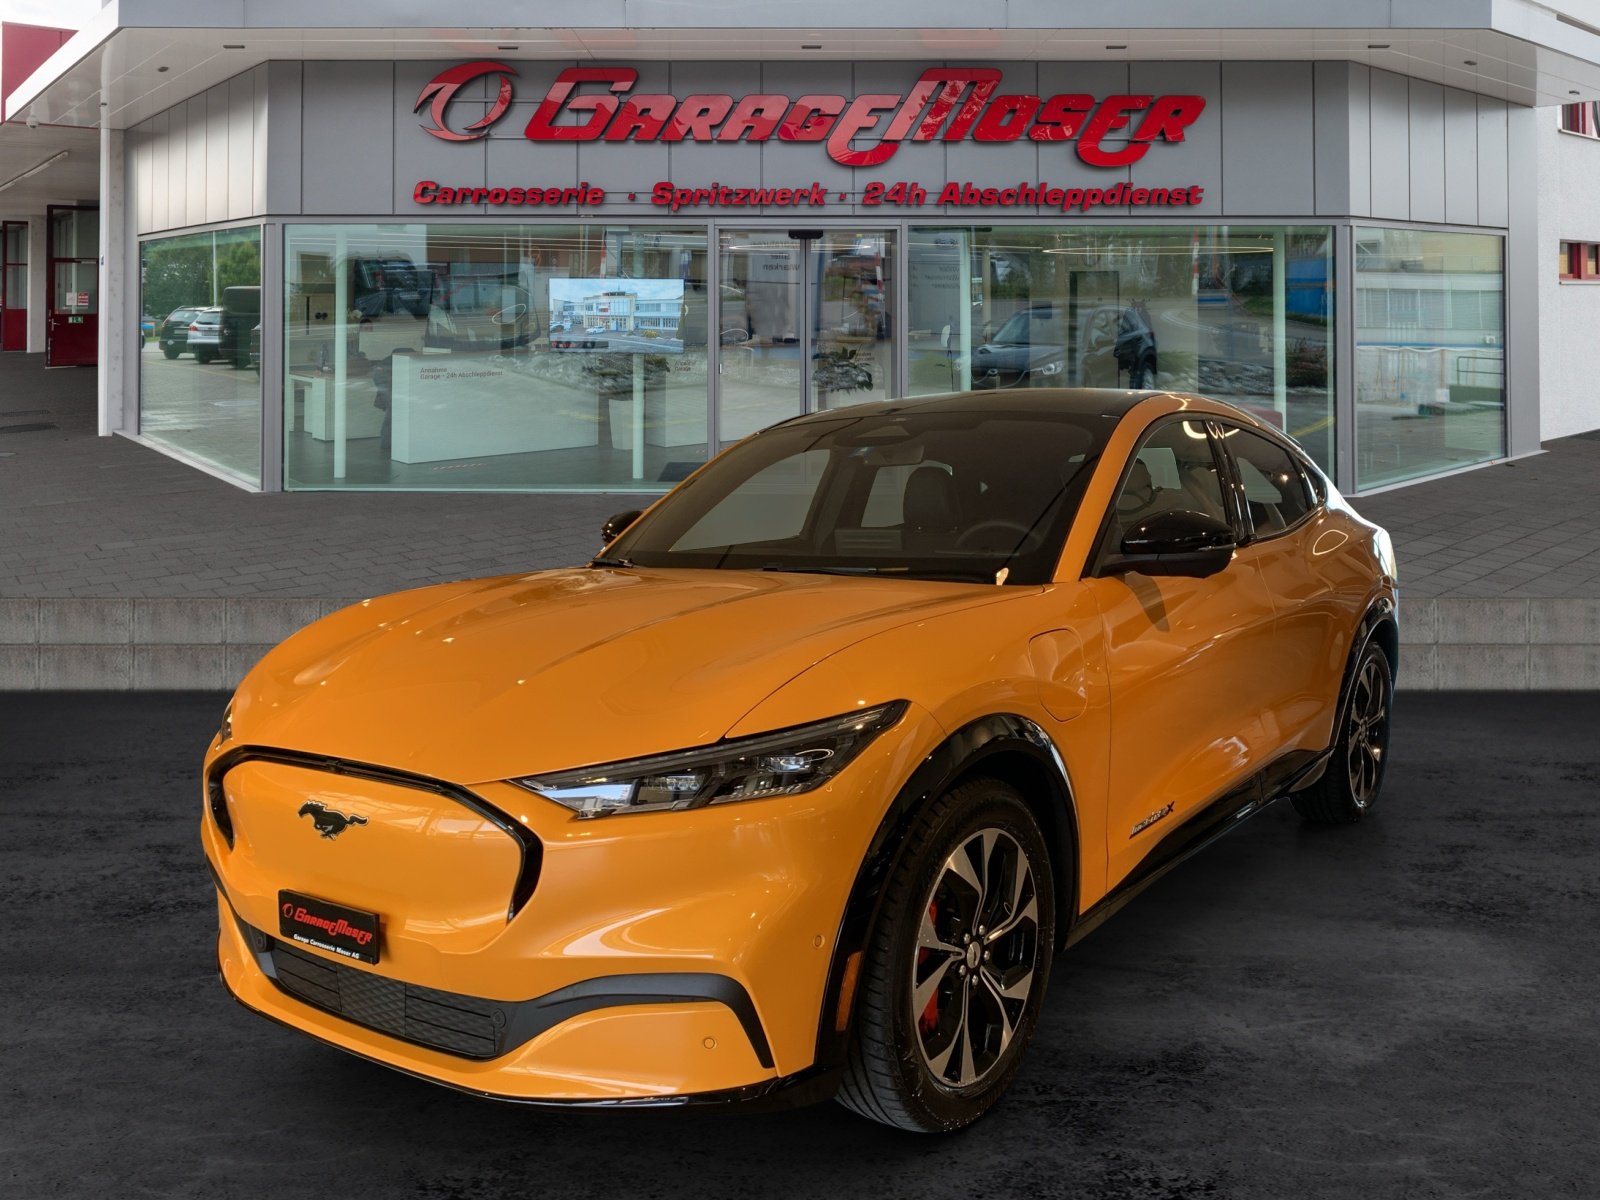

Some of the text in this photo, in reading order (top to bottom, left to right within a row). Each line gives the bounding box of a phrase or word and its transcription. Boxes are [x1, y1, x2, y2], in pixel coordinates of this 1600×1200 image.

[413, 181, 1203, 211] Carrosserie Spritzwerk 24h Abschleppdienst
[336, 947, 351, 956] Moser
